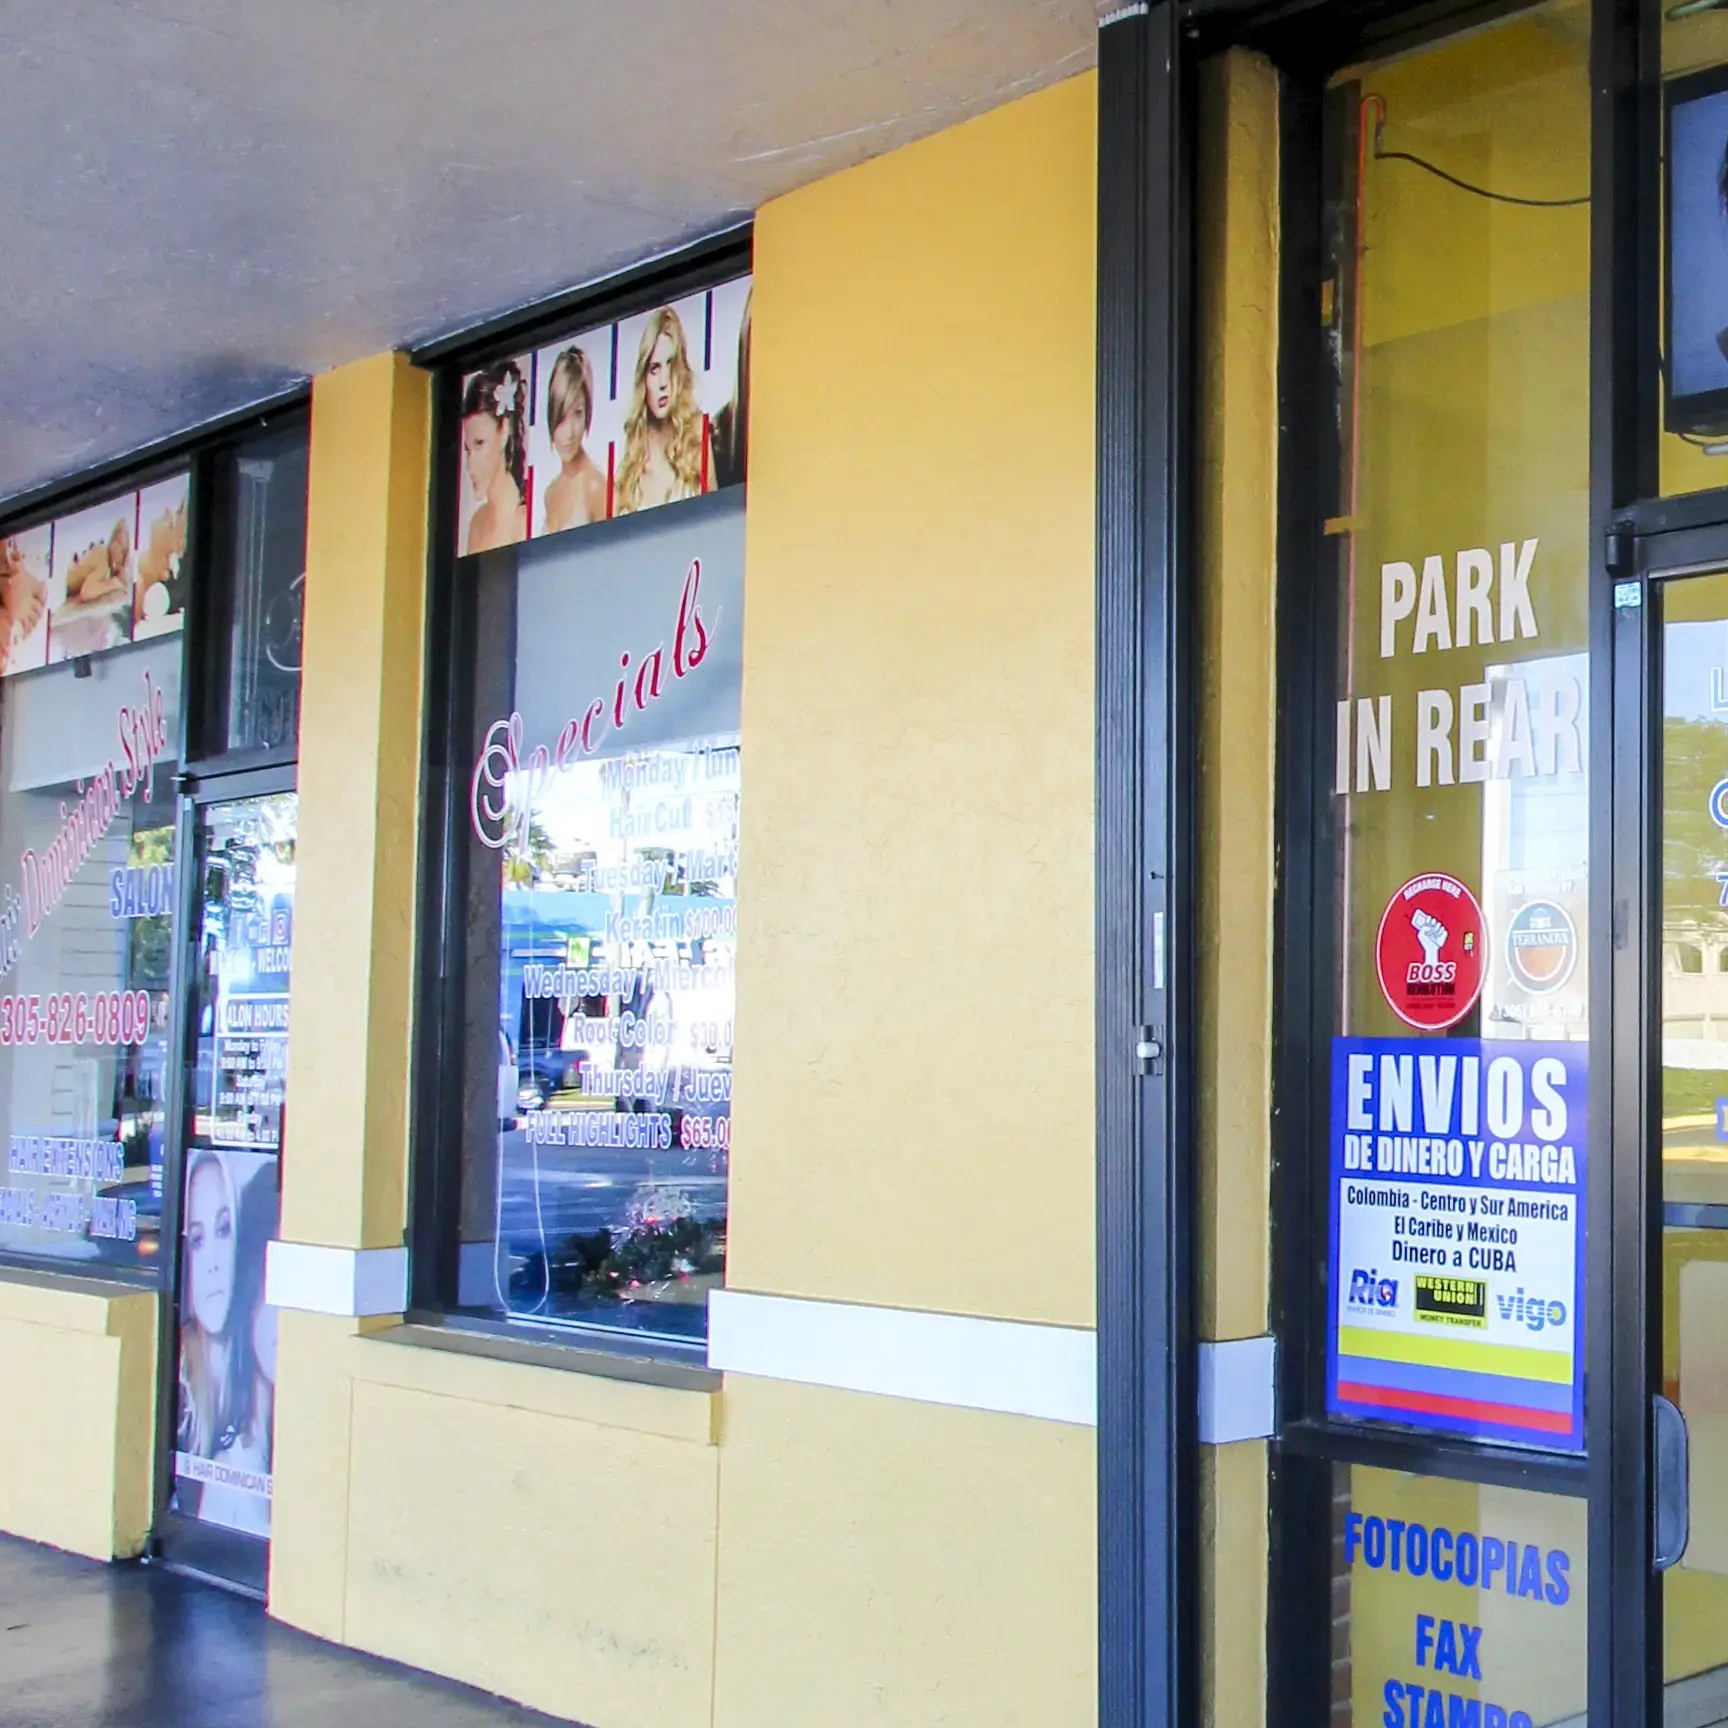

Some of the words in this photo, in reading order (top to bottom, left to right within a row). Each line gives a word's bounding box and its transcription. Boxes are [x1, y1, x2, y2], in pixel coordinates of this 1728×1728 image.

[1380, 537, 1540, 659] PARK
[470, 557, 723, 864] Specials
[1335, 694, 1392, 796] IN
[1416, 677, 1583, 787] REAR
[109, 864, 174, 919] SALON
[523, 964, 636, 1004] Wednesday
[1406, 962, 1457, 983] BOSS
[0, 990, 150, 1045] 305-826-0809
[579, 1061, 669, 1105] Thursday
[1347, 1053, 1568, 1141] ENVIOS
[525, 1110, 566, 1144] FULL
[568, 1112, 672, 1149] HIGHLIGHTS
[1344, 1134, 1373, 1171] DE
[1378, 1136, 1464, 1177] DINERO
[1468, 1140, 1485, 1178] Y
[1489, 1141, 1576, 1184] CARGA
[1347, 1186, 1409, 1208] Colombia
[1421, 1191, 1466, 1212] Centro
[1469, 1198, 1477, 1216] y
[1480, 1195, 1504, 1215] Sur
[1507, 1197, 1568, 1221] America
[1394, 1216, 1405, 1235] El
[1408, 1217, 1452, 1239] Caribe
[1456, 1224, 1464, 1242] y
[1467, 1222, 1517, 1245] Mexico
[1392, 1240, 1446, 1266] Dinero
[1453, 1251, 1462, 1267] a
[1469, 1247, 1517, 1273] CUBA
[1349, 1268, 1399, 1307] Ria
[1416, 1276, 1474, 1292] WESTERN
[1434, 1290, 1474, 1305] UNION
[1420, 1313, 1443, 1323] MONEY
[1446, 1316, 1482, 1327] TRANSFER
[1496, 1287, 1567, 1331] vigo
[1344, 1511, 1570, 1606] FOTOCOPIAS
[1416, 1613, 1483, 1681] FAX
